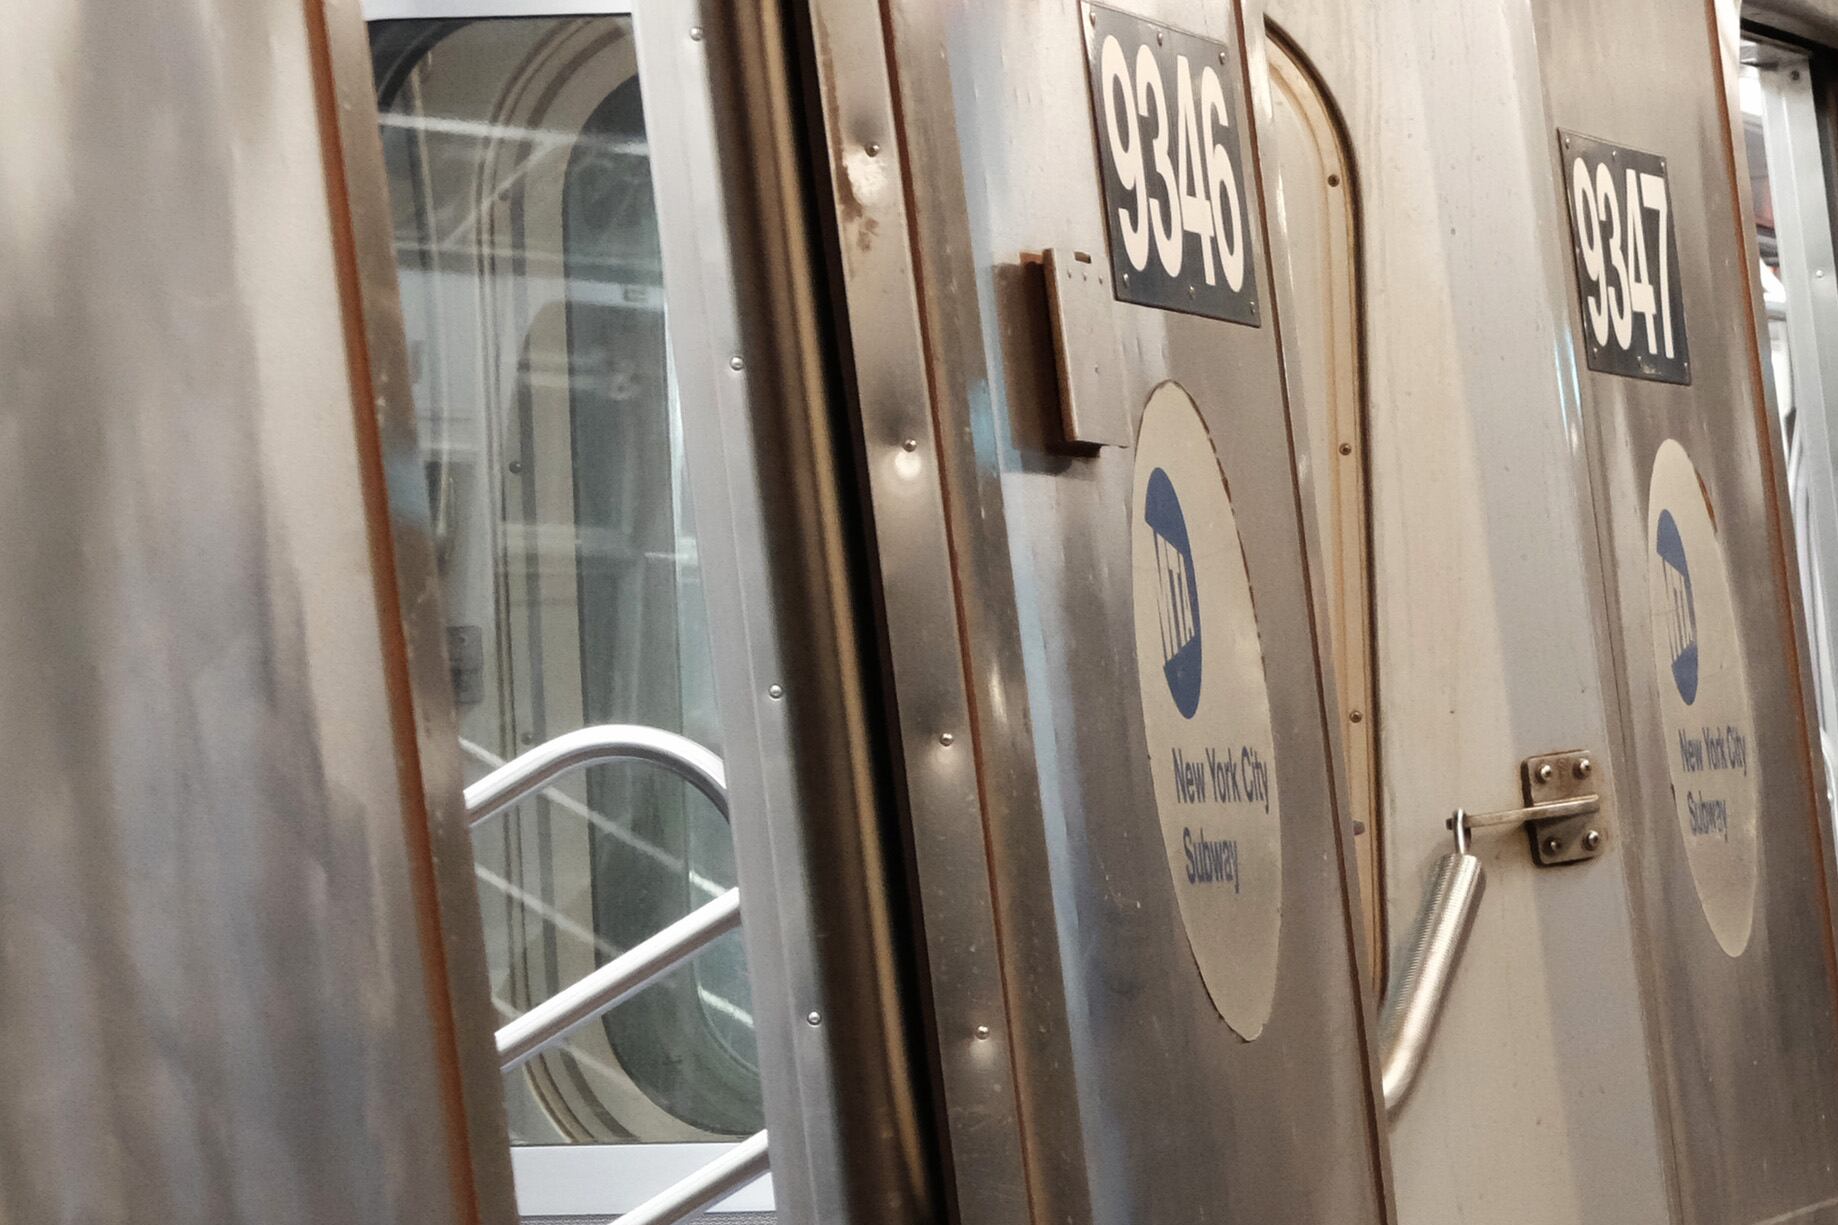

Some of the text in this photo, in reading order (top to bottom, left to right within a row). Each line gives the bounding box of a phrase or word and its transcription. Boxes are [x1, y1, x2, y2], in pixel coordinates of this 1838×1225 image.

[1100, 33, 1245, 293] 9346
[1571, 155, 1677, 361] 9347
[1171, 745, 1270, 815] New York City
[1678, 725, 1747, 777] New York City
[1686, 790, 1728, 844] Subway
[1182, 826, 1240, 895] Subway
